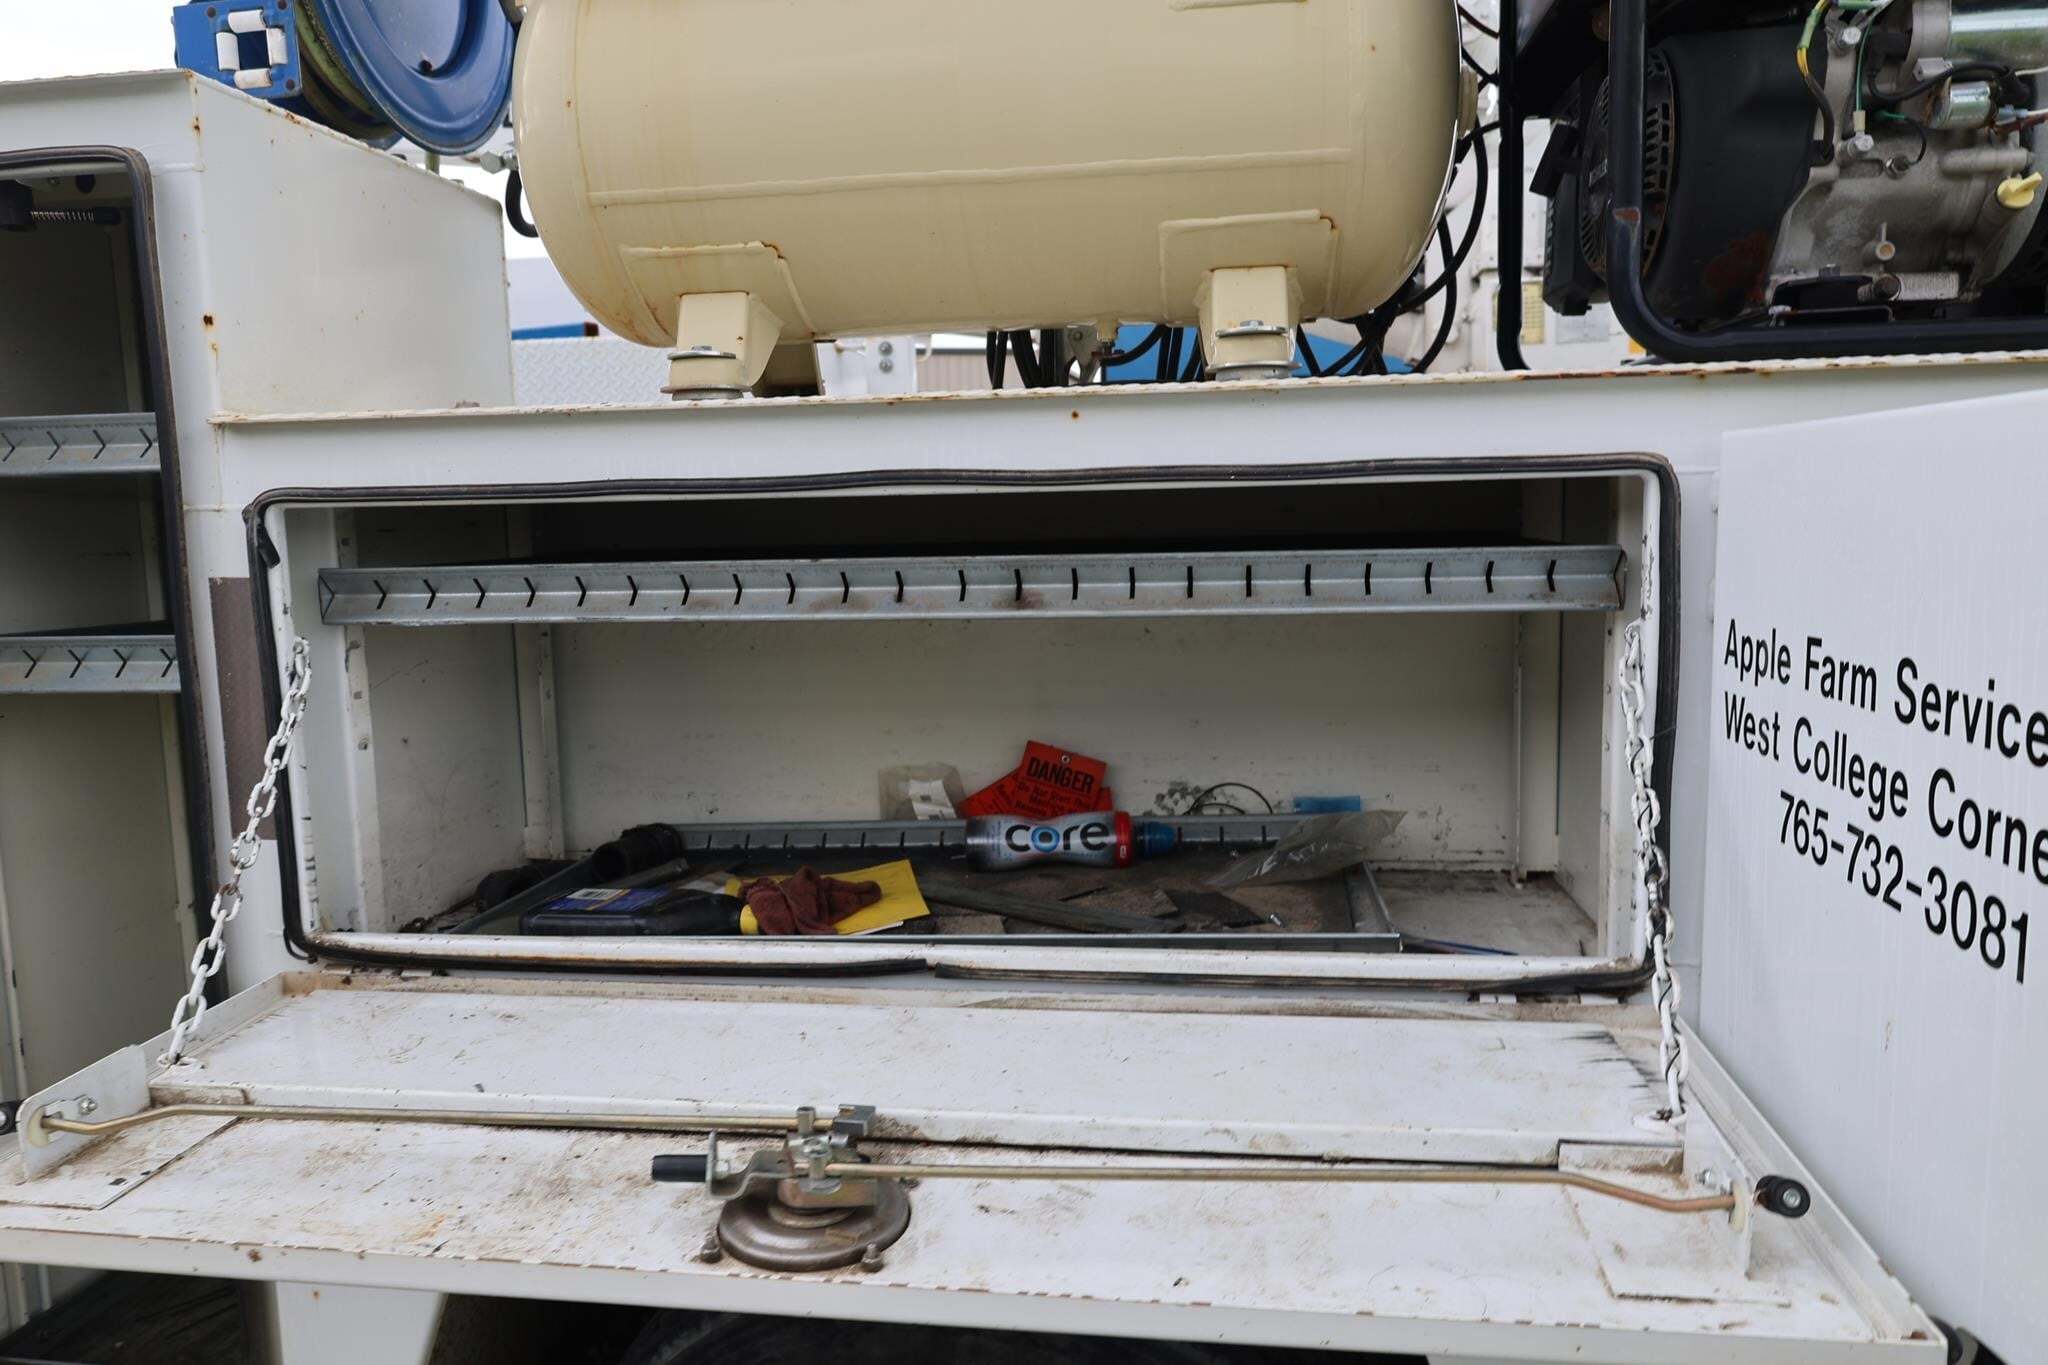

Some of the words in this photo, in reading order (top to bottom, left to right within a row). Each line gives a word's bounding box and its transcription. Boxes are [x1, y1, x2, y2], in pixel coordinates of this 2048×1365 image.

[1724, 619, 1791, 687] Apple
[1804, 636, 1877, 712] Farm
[1894, 657, 2048, 768] Service
[1725, 691, 1780, 761] West
[1793, 717, 1908, 822] College
[1005, 822, 1109, 852] core
[1028, 757, 1095, 793] DANGER
[1780, 790, 2029, 985] 765-732-3081
